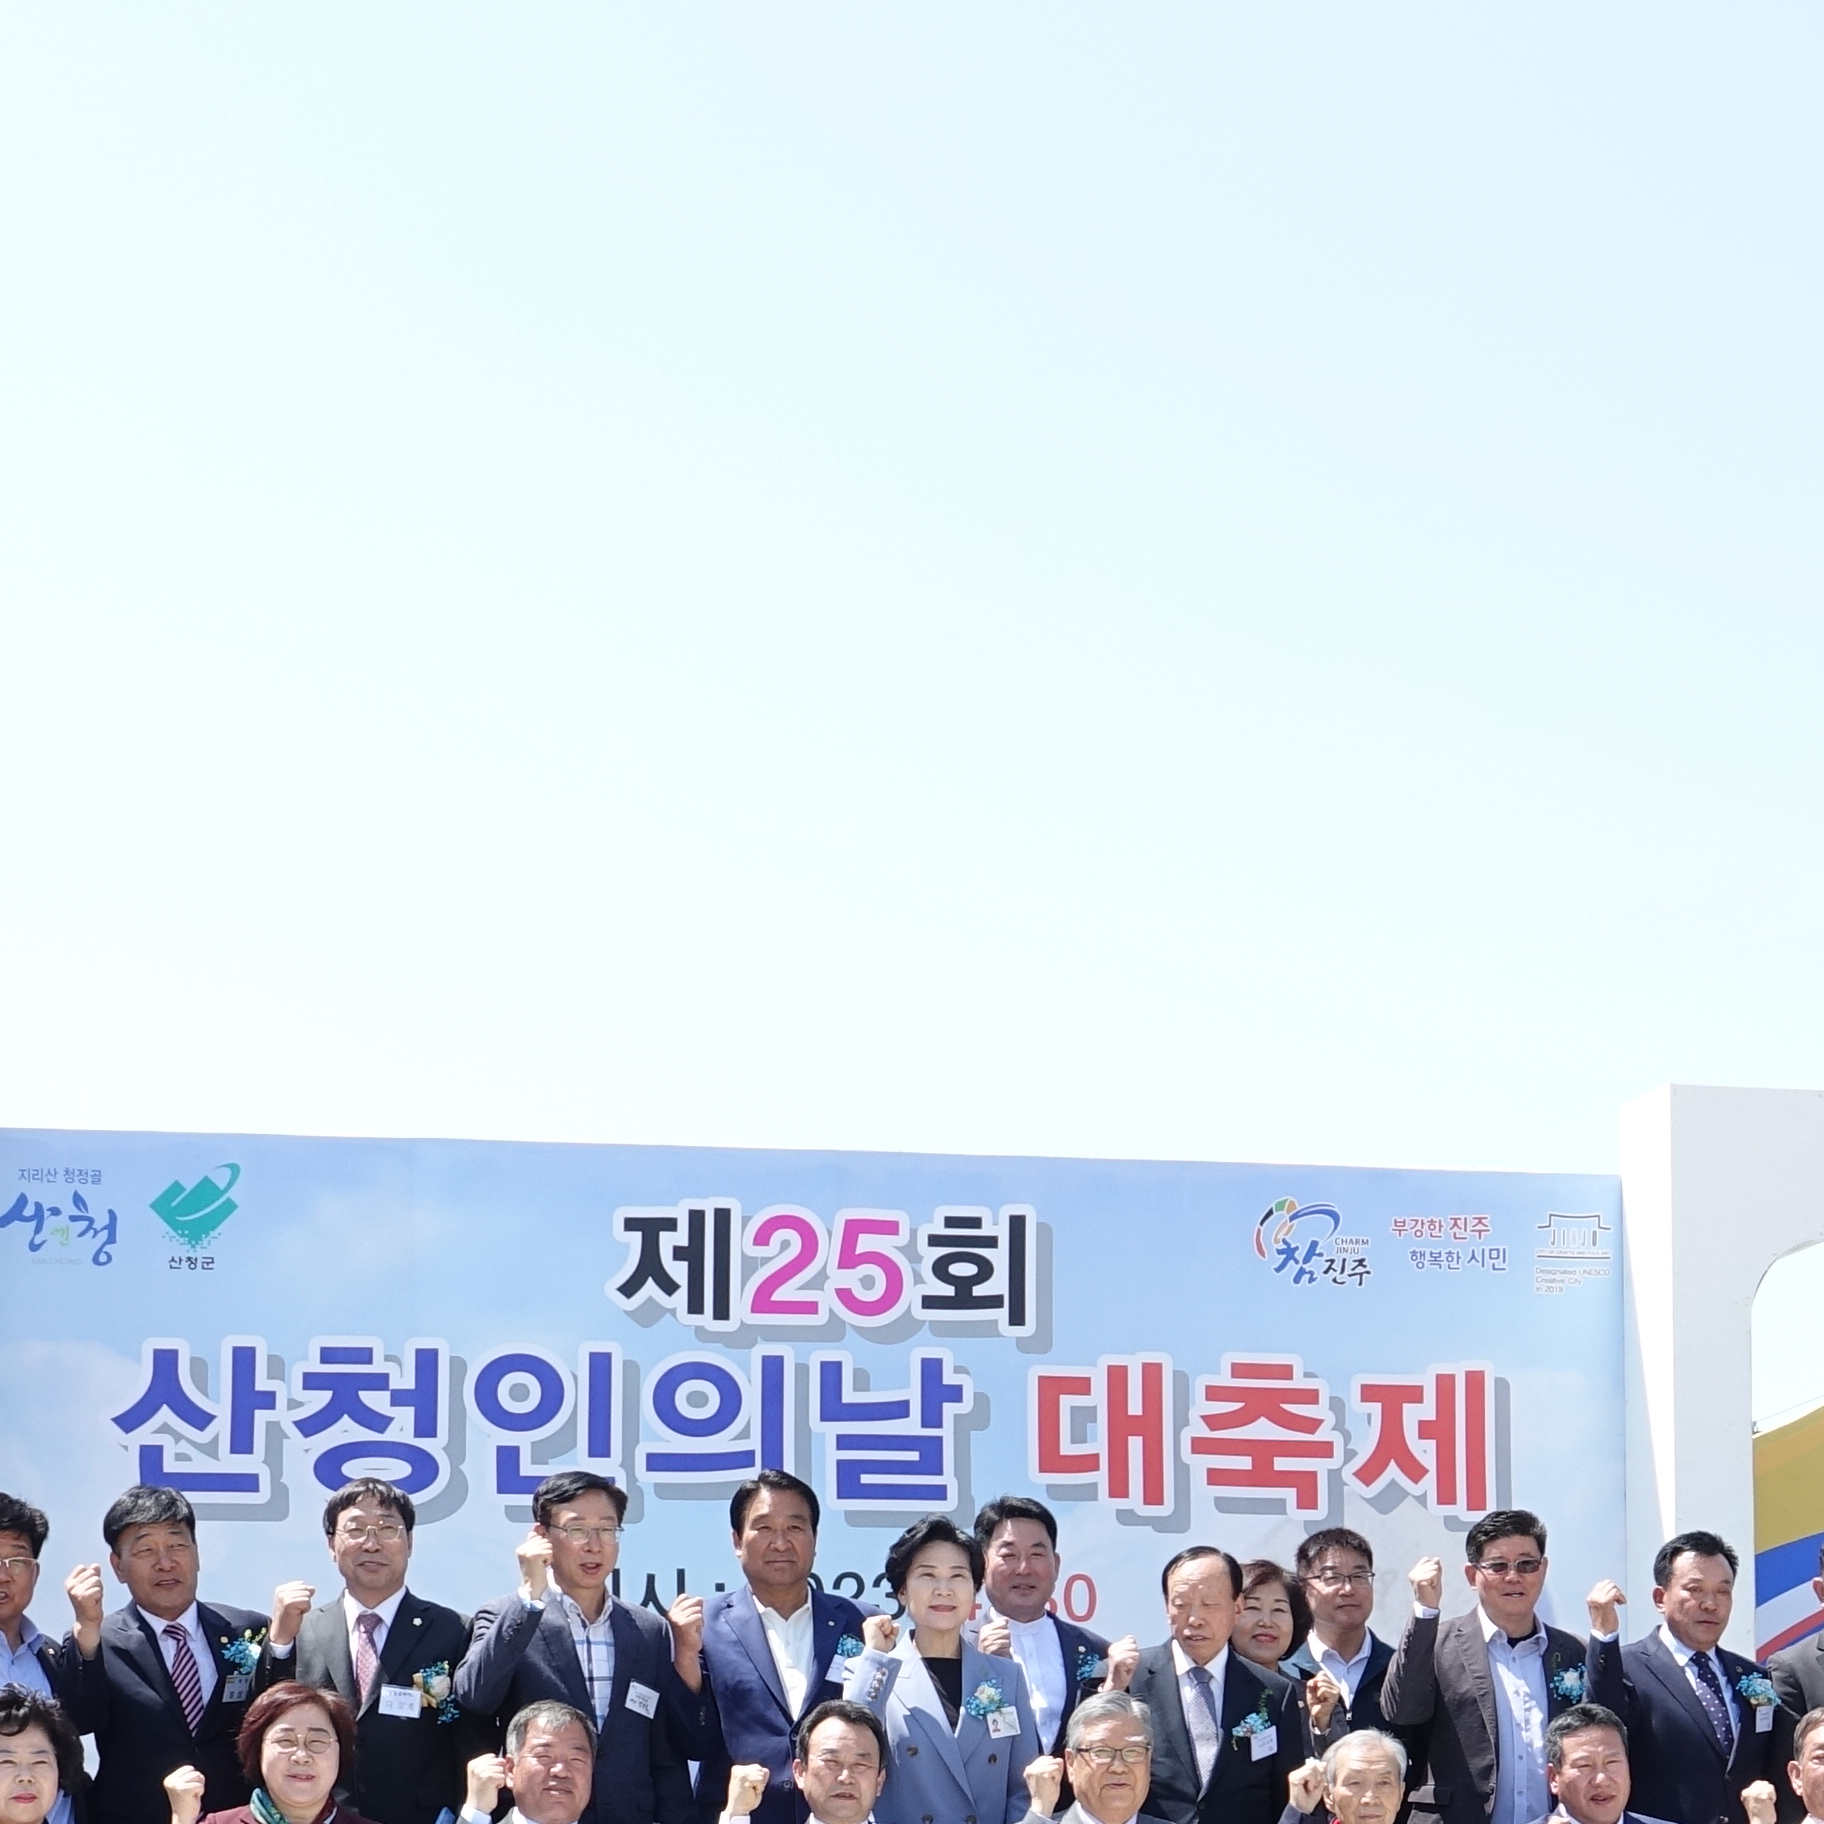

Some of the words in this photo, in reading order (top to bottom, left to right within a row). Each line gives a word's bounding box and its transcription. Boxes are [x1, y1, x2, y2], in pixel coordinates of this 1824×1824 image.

[18, 1167, 58, 1183] 지리산
[63, 1168, 102, 1185] 청정골
[1391, 1217, 1443, 1239] 부강한
[1449, 1216, 1491, 1240] 진주
[1334, 1238, 1369, 1246] CHARM
[168, 1256, 216, 1270] 산청군
[616, 1205, 1029, 1328] 제25회
[1409, 1249, 1461, 1271] 행복한
[1467, 1247, 1507, 1271] 시민
[1323, 1258, 1371, 1286] 진주
[112, 1344, 964, 1502] 산청인의날
[1037, 1362, 1488, 1511] 대축제
